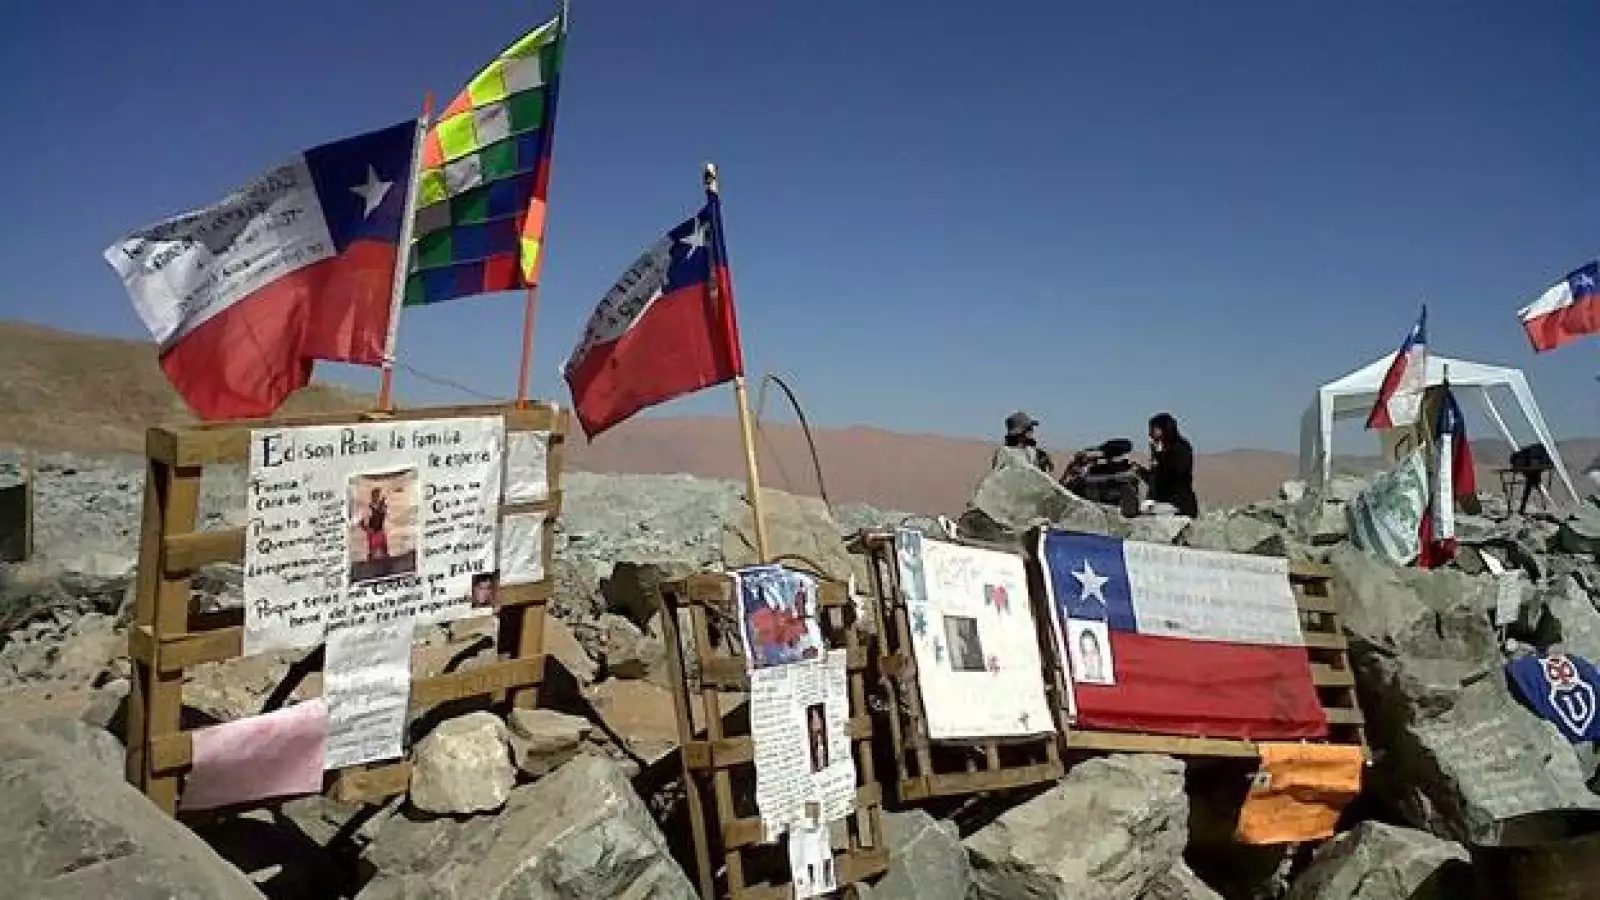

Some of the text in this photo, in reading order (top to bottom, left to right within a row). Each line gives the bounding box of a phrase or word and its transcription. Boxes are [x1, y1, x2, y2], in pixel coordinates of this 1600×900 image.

[263, 433, 334, 467] Edison
[341, 428, 378, 457] Peña
[412, 430, 461, 449] familia
